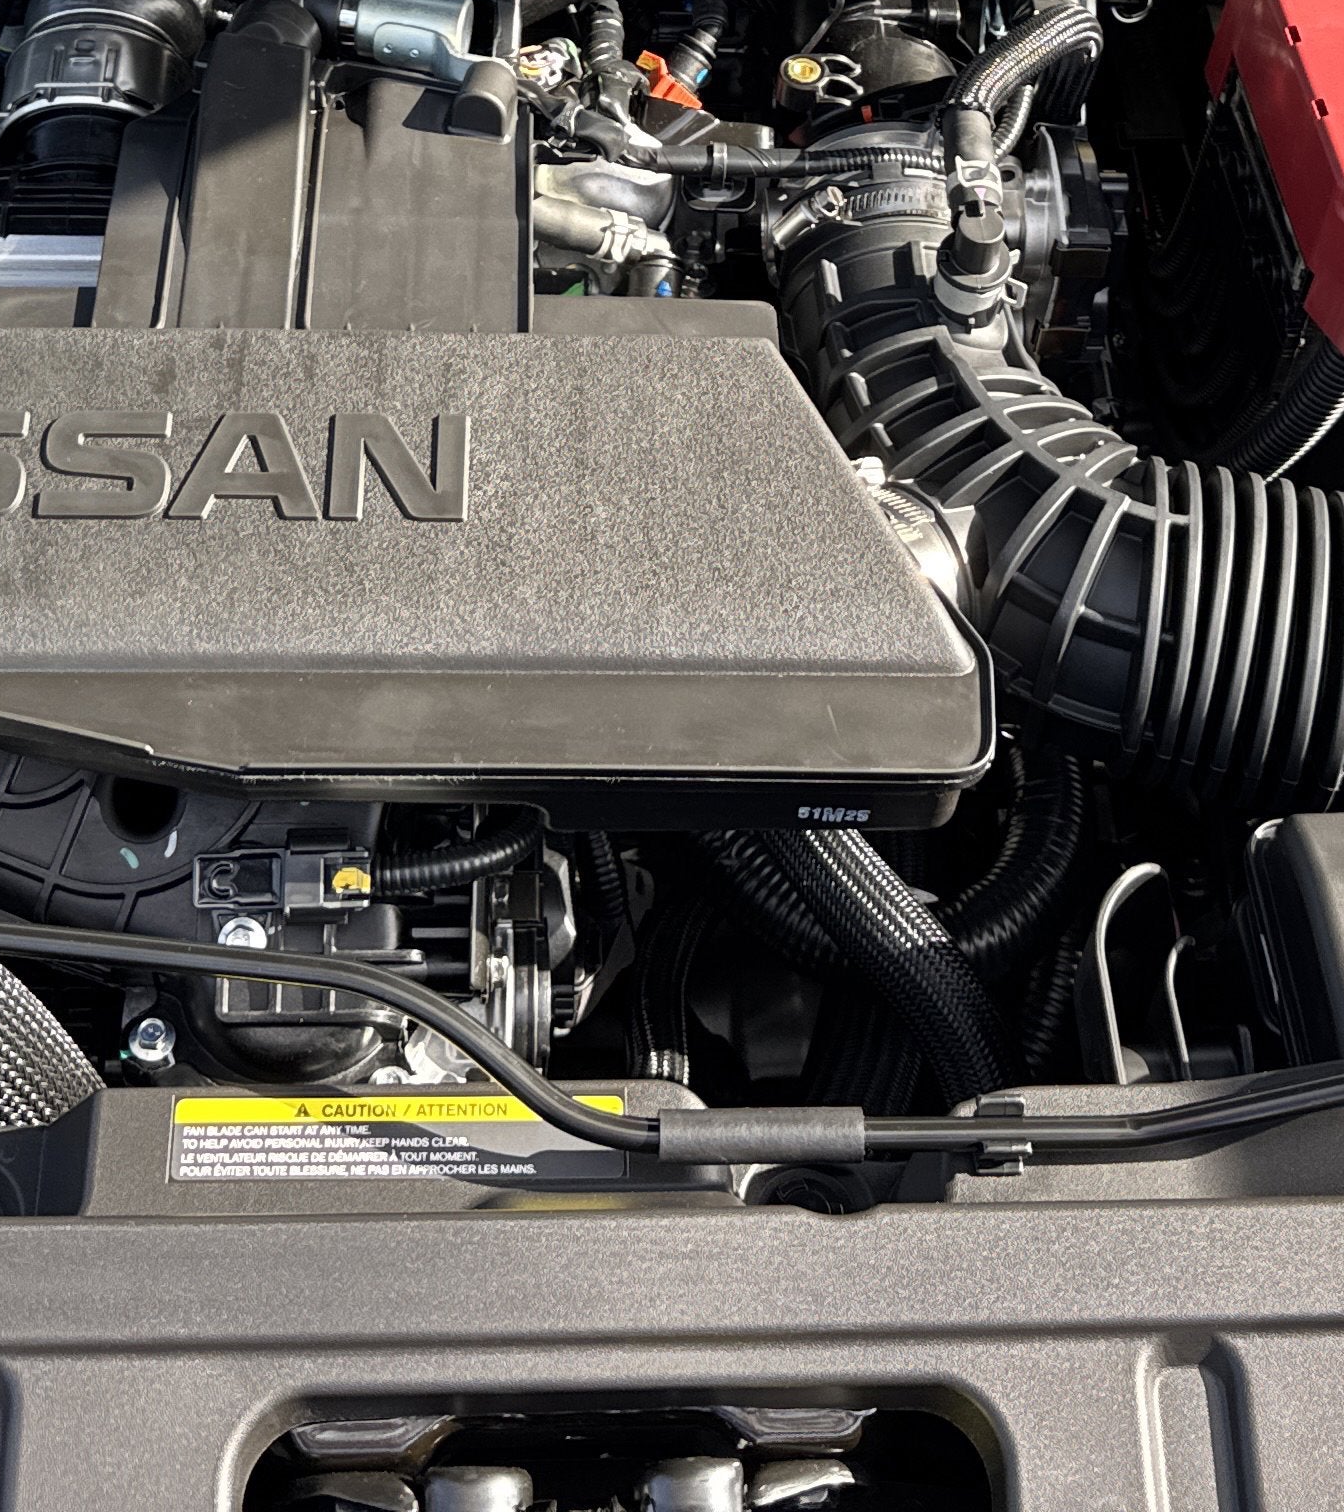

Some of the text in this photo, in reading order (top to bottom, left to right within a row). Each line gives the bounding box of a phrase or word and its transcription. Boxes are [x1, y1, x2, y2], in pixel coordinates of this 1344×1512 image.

[322, 1104, 397, 1118] CAUTION
[416, 1103, 508, 1117] ATTENTION
[183, 1125, 205, 1136] FAN
[207, 1125, 242, 1136] BLADE
[244, 1125, 269, 1136] CAN
[270, 1125, 303, 1136] START
[305, 1125, 319, 1136] AT
[319, 1125, 342, 1136] ANY
[183, 1138, 197, 1149] TO
[200, 1138, 228, 1149] HELP
[229, 1138, 263, 1149] AVOID
[265, 1138, 322, 1149] PERSONAL
[391, 1137, 429, 1148] HANDS
[181, 1152, 194, 1163] LE
[197, 1152, 267, 1163] VENTILATEUR
[268, 1152, 309, 1163] RISQUE
[311, 1152, 326, 1163] DE
[328, 1150, 388, 1163] DÉMARRER
[400, 1151, 427, 1162] TOUT
[430, 1151, 479, 1162] MOMENT.
[180, 1165, 211, 1176] POUR
[213, 1162, 251, 1176] ÉVITER
[253, 1165, 287, 1176] TOUTE
[350, 1165, 366, 1176] NE
[368, 1165, 390, 1176] PAS
[392, 1165, 407, 1176] EN
[408, 1164, 476, 1174] APPROCHER
[478, 1164, 498, 1174] LES
[500, 1164, 537, 1174] MAINS.
